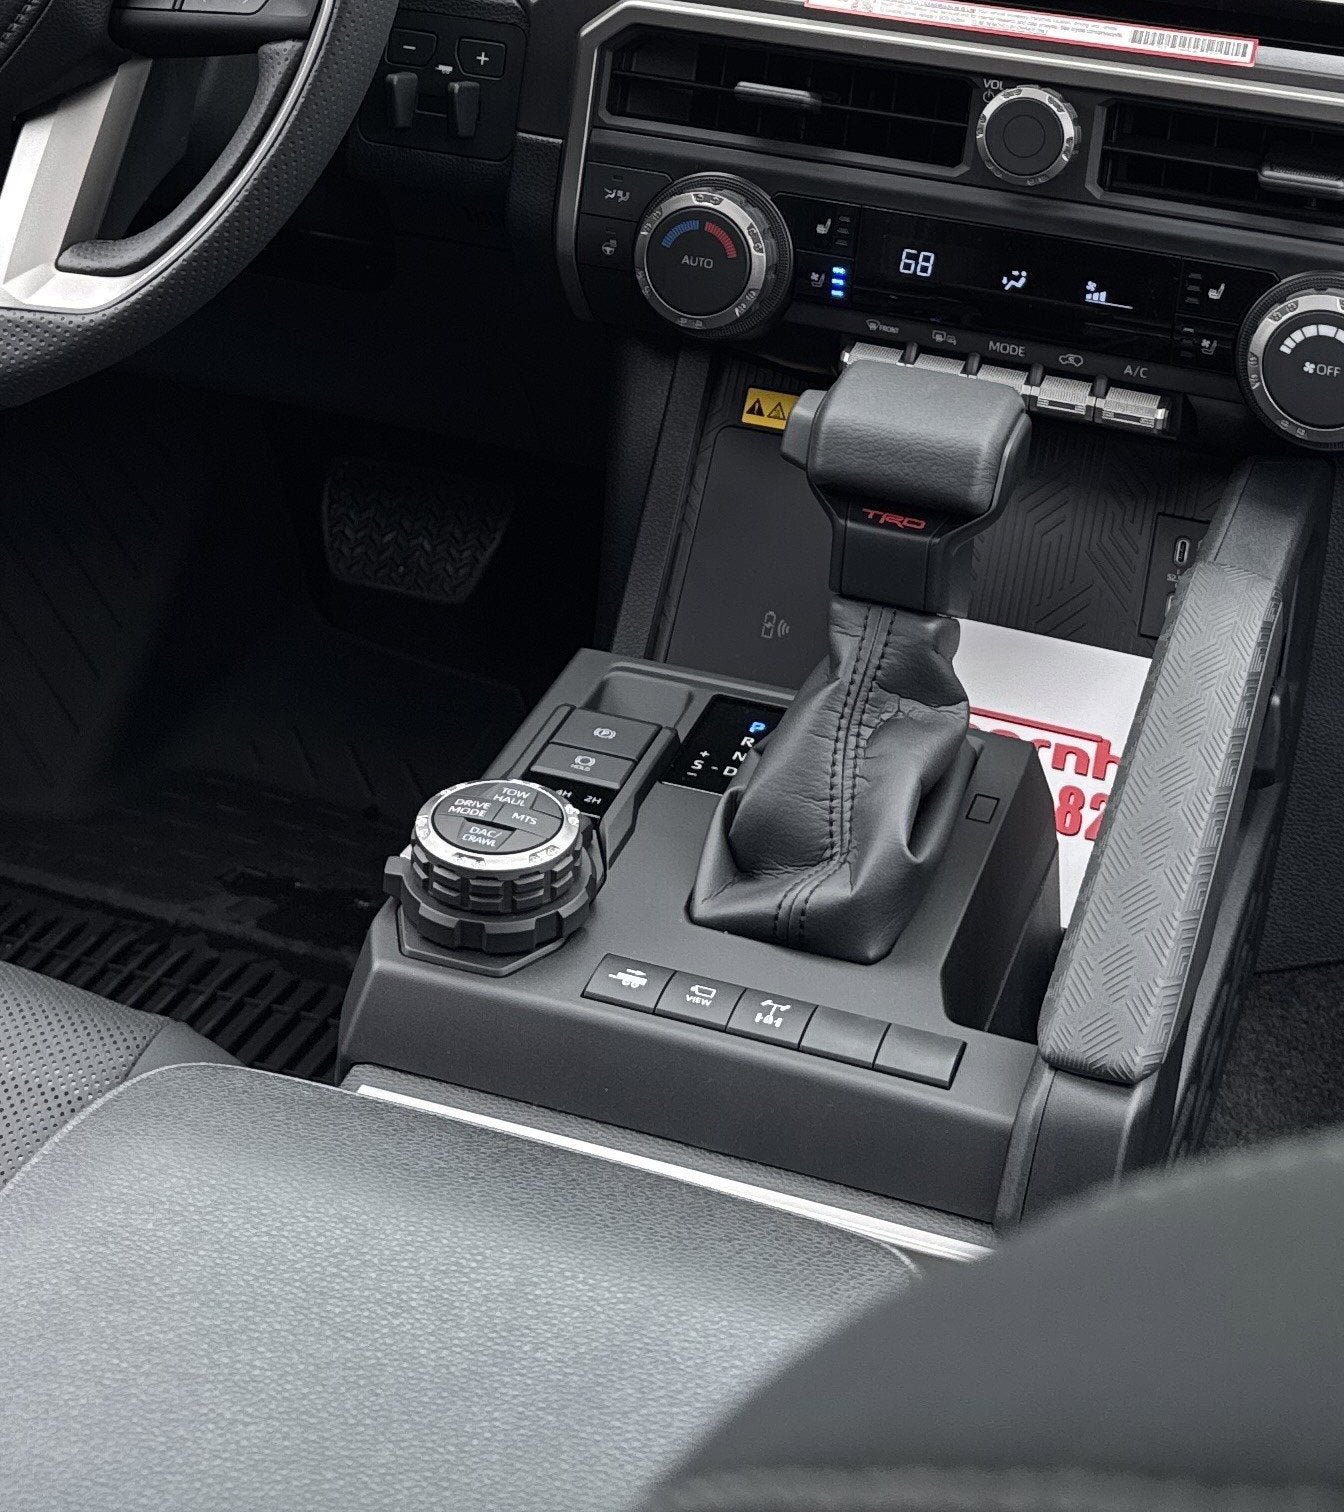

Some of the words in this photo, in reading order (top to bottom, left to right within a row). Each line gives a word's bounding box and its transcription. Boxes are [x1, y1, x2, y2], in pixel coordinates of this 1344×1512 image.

[983, 78, 1003, 89] VOL
[681, 253, 715, 270] AUTO
[899, 248, 935, 277] 68
[879, 324, 900, 334] FRONT
[988, 340, 1026, 358] MODE
[1124, 364, 1148, 379] A/C
[1316, 363, 1342, 378] OFF
[862, 508, 927, 531] TRD
[749, 721, 766, 734] P
[741, 736, 755, 747] R
[732, 751, 748, 762] N
[571, 763, 591, 772] HOLD
[690, 759, 704, 770] S
[722, 765, 738, 777] D
[501, 787, 531, 799] TOW
[584, 794, 602, 805] 2H
[454, 799, 492, 809] DRIVE
[493, 794, 526, 807] HAUL
[448, 805, 487, 818] MODE
[511, 812, 538, 825] MTS
[469, 826, 504, 838] DAC/
[462, 834, 497, 847] CRAWL
[685, 994, 712, 1006] VIEW
